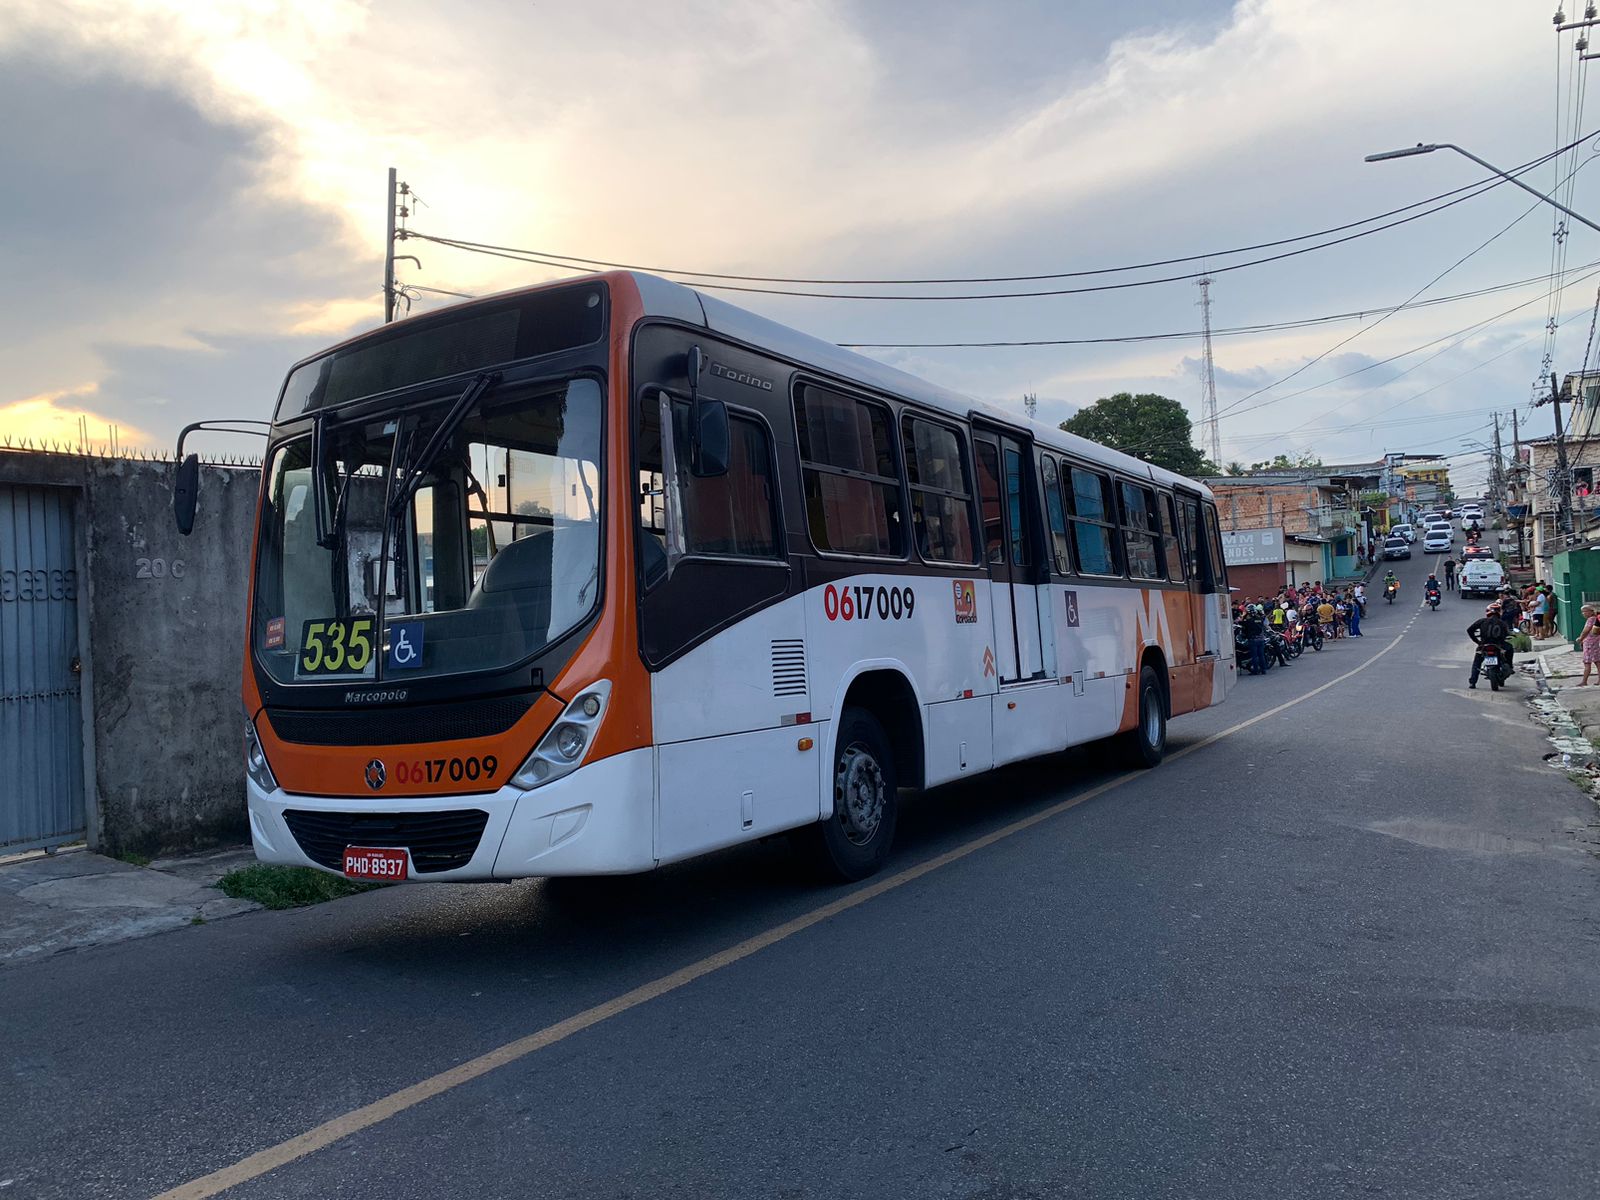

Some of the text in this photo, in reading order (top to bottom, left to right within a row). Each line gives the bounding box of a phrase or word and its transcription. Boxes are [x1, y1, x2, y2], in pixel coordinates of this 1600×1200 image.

[713, 363, 773, 390] Torino
[135, 557, 167, 579] 20
[823, 583, 915, 622] 0617009
[303, 620, 371, 672] 535
[344, 689, 407, 703] Marcopolo
[395, 754, 499, 784] 0617009
